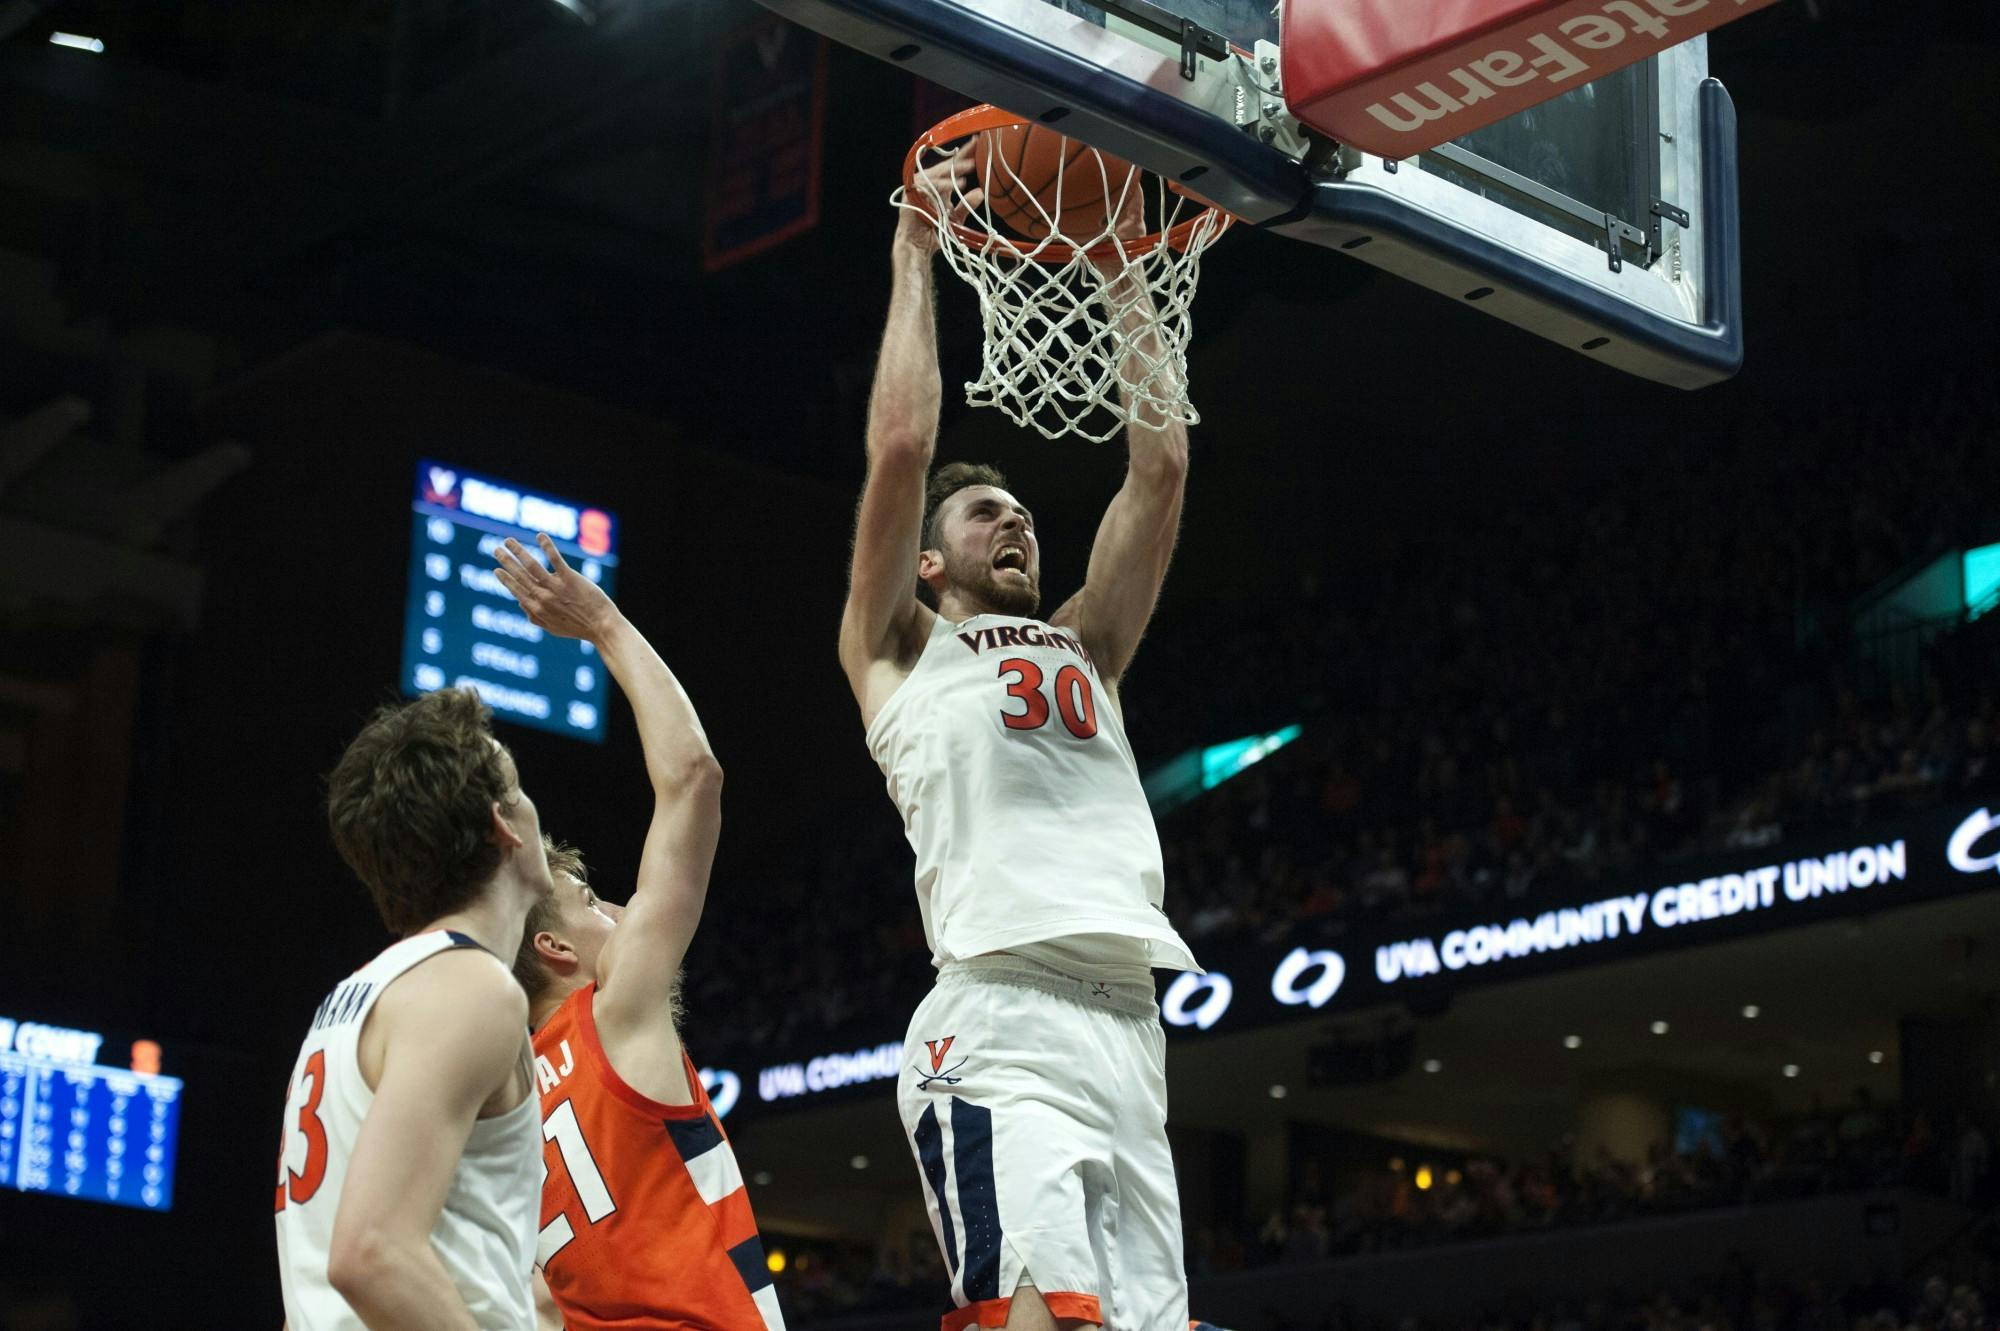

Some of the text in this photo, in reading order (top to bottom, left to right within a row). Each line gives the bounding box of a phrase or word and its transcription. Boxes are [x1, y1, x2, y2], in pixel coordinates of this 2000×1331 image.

[1365, 0, 1744, 132] ateFarm
[998, 658, 1098, 739] 30
[1375, 839, 1906, 983] UVA COMMUNITY CREDIT UNION
[535, 1039, 575, 1098] AJ
[758, 1062, 808, 1102] UVA
